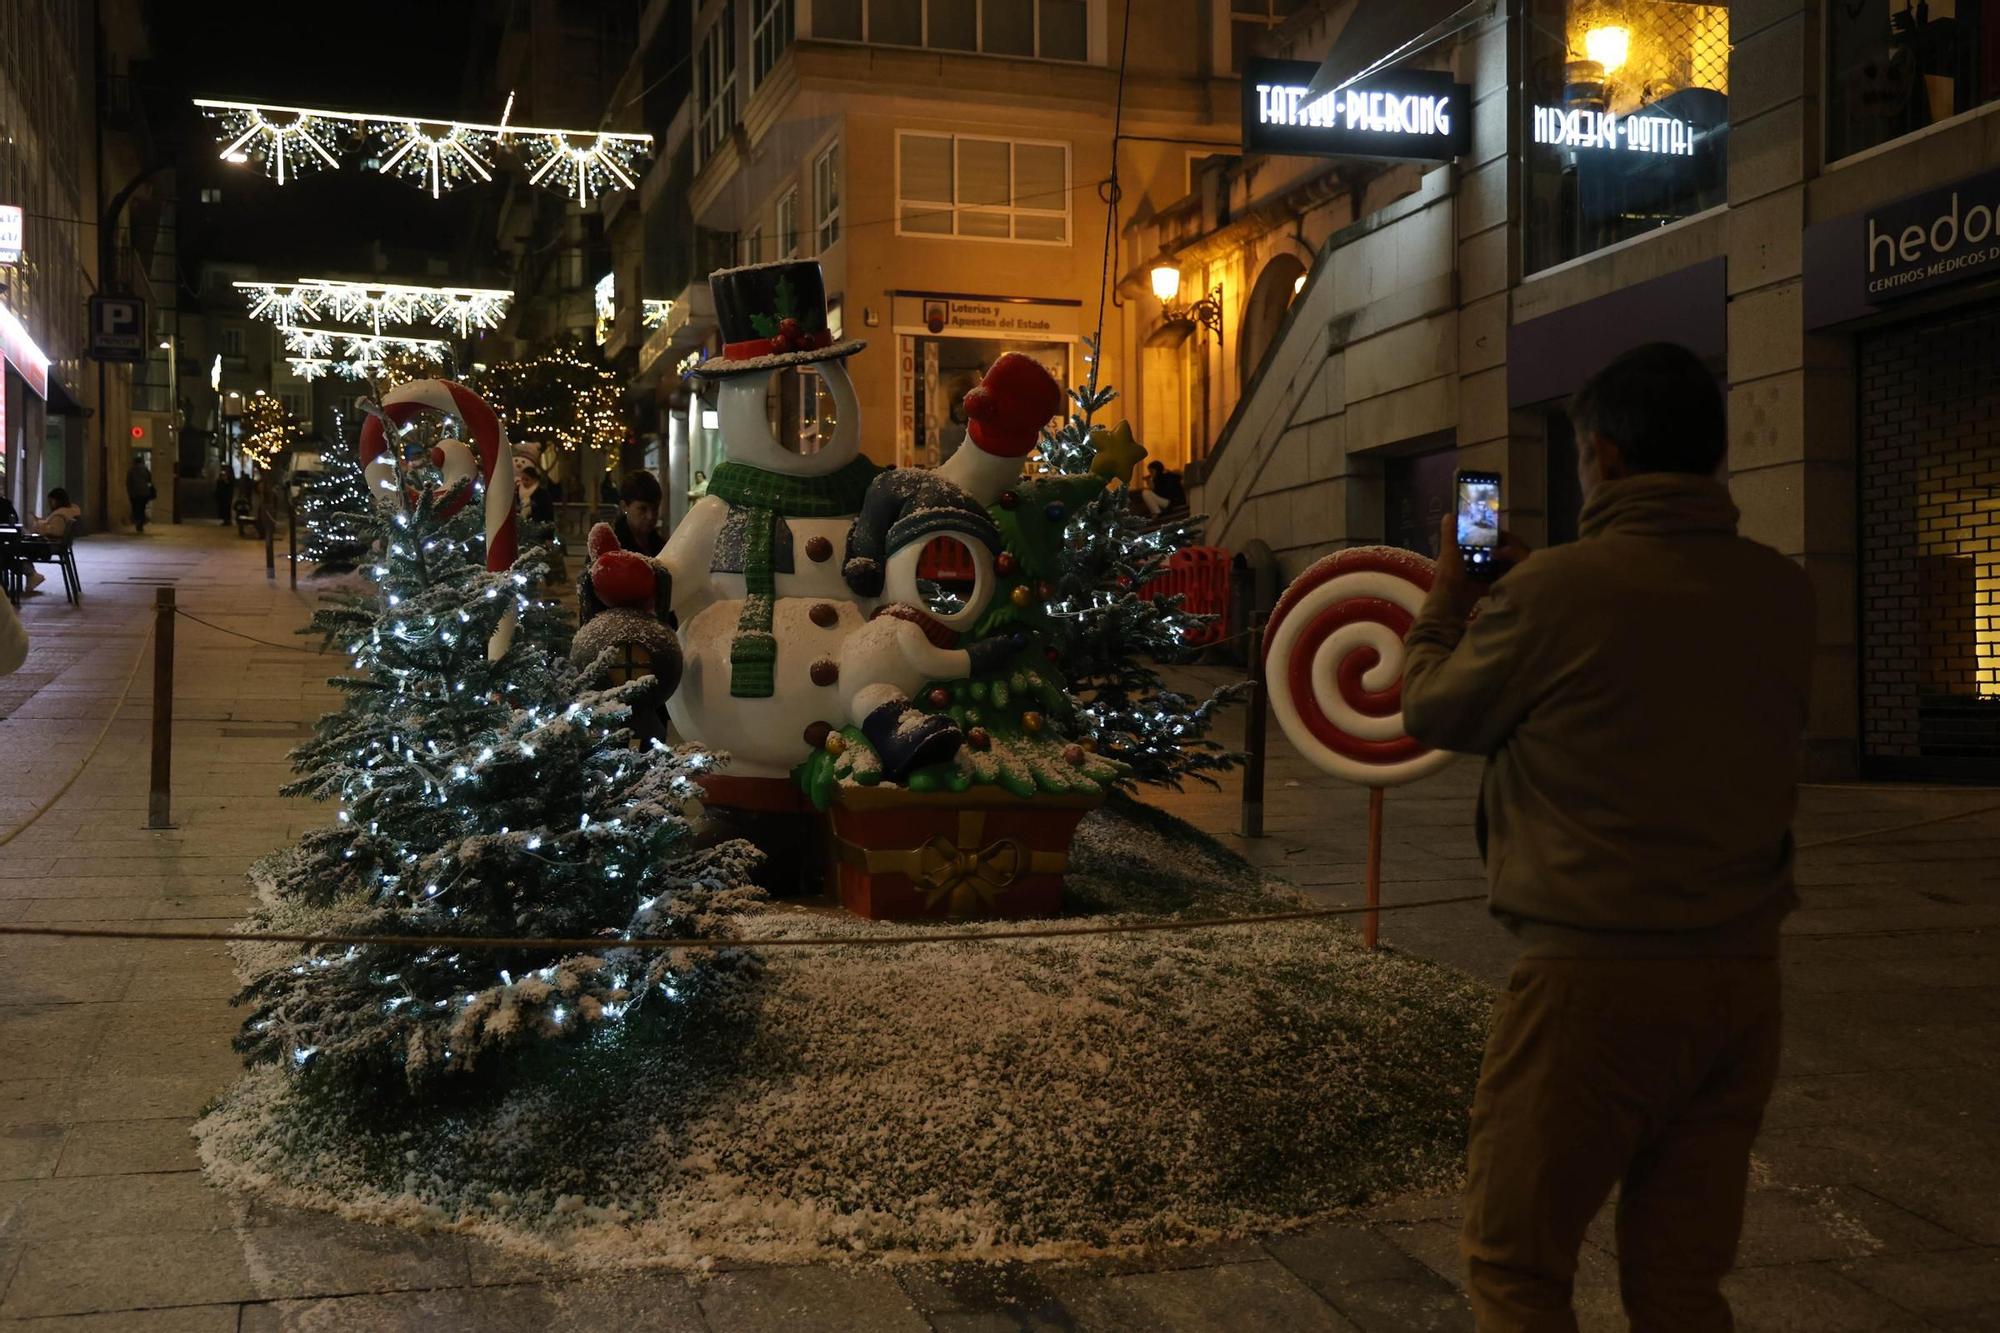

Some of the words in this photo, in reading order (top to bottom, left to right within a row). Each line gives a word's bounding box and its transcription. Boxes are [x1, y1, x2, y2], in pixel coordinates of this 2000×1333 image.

[1868, 269, 1925, 293] CENTROS
[102, 303, 134, 335] P
[993, 307, 1000, 317] y
[951, 316, 996, 328] Apuestas
[999, 317, 1014, 328] del
[1017, 319, 1050, 330] Estado
